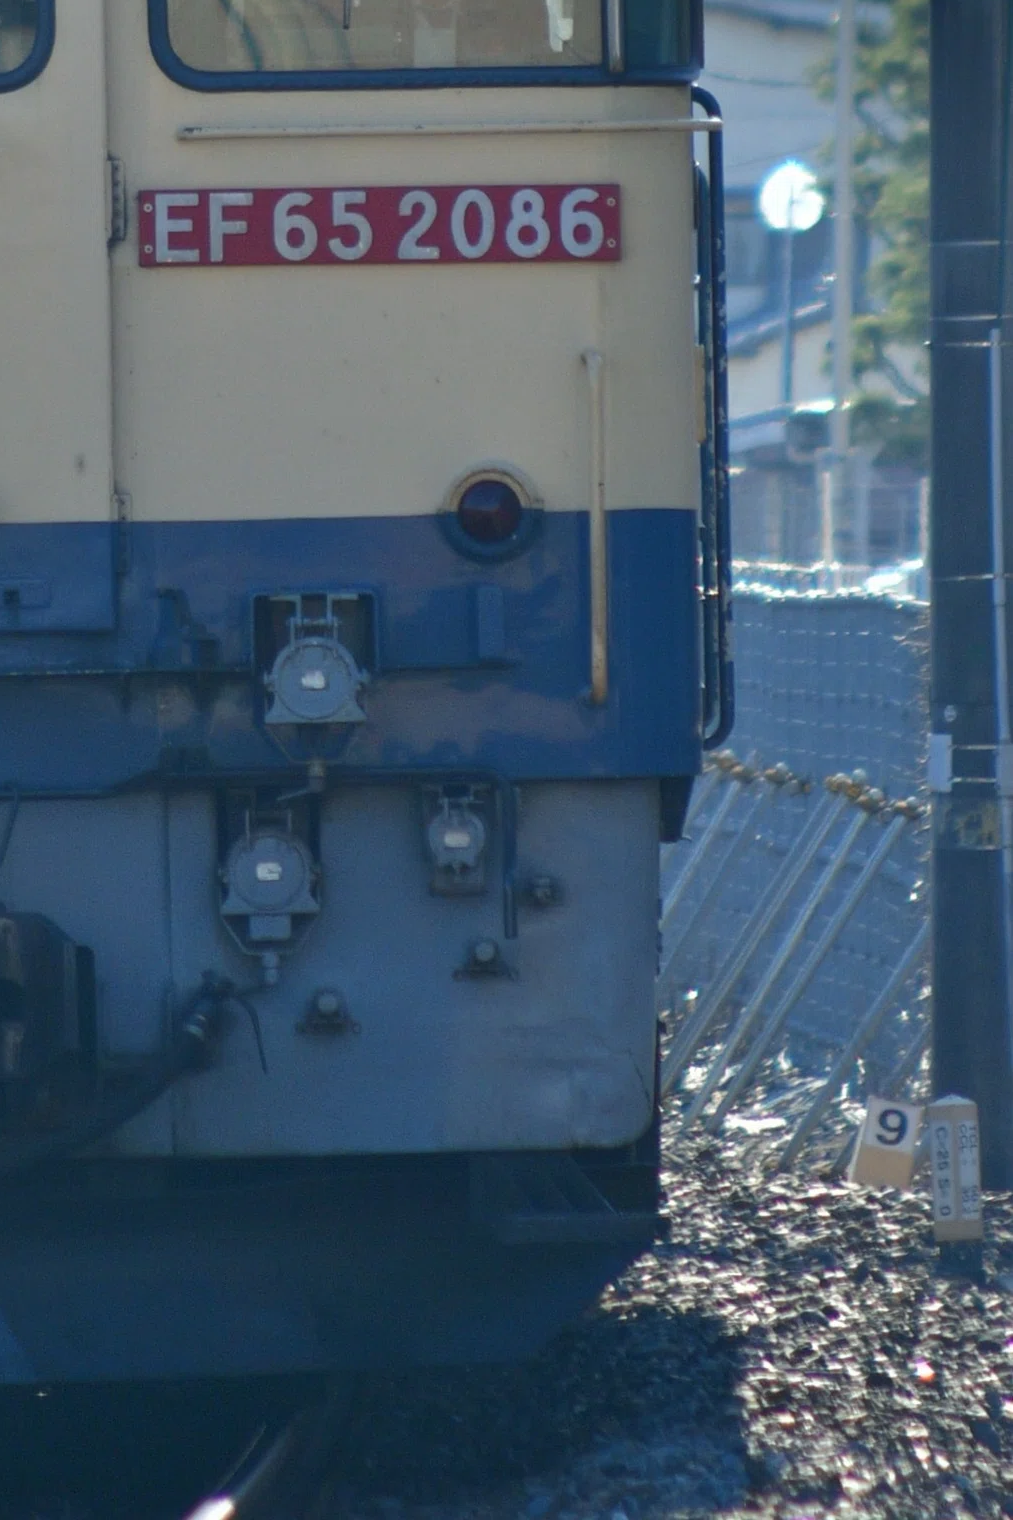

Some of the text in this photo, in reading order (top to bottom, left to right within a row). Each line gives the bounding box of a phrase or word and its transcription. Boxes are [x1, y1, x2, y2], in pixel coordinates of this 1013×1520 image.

[154, 188, 604, 263] EF 65 2086
[875, 1108, 909, 1146] 9
